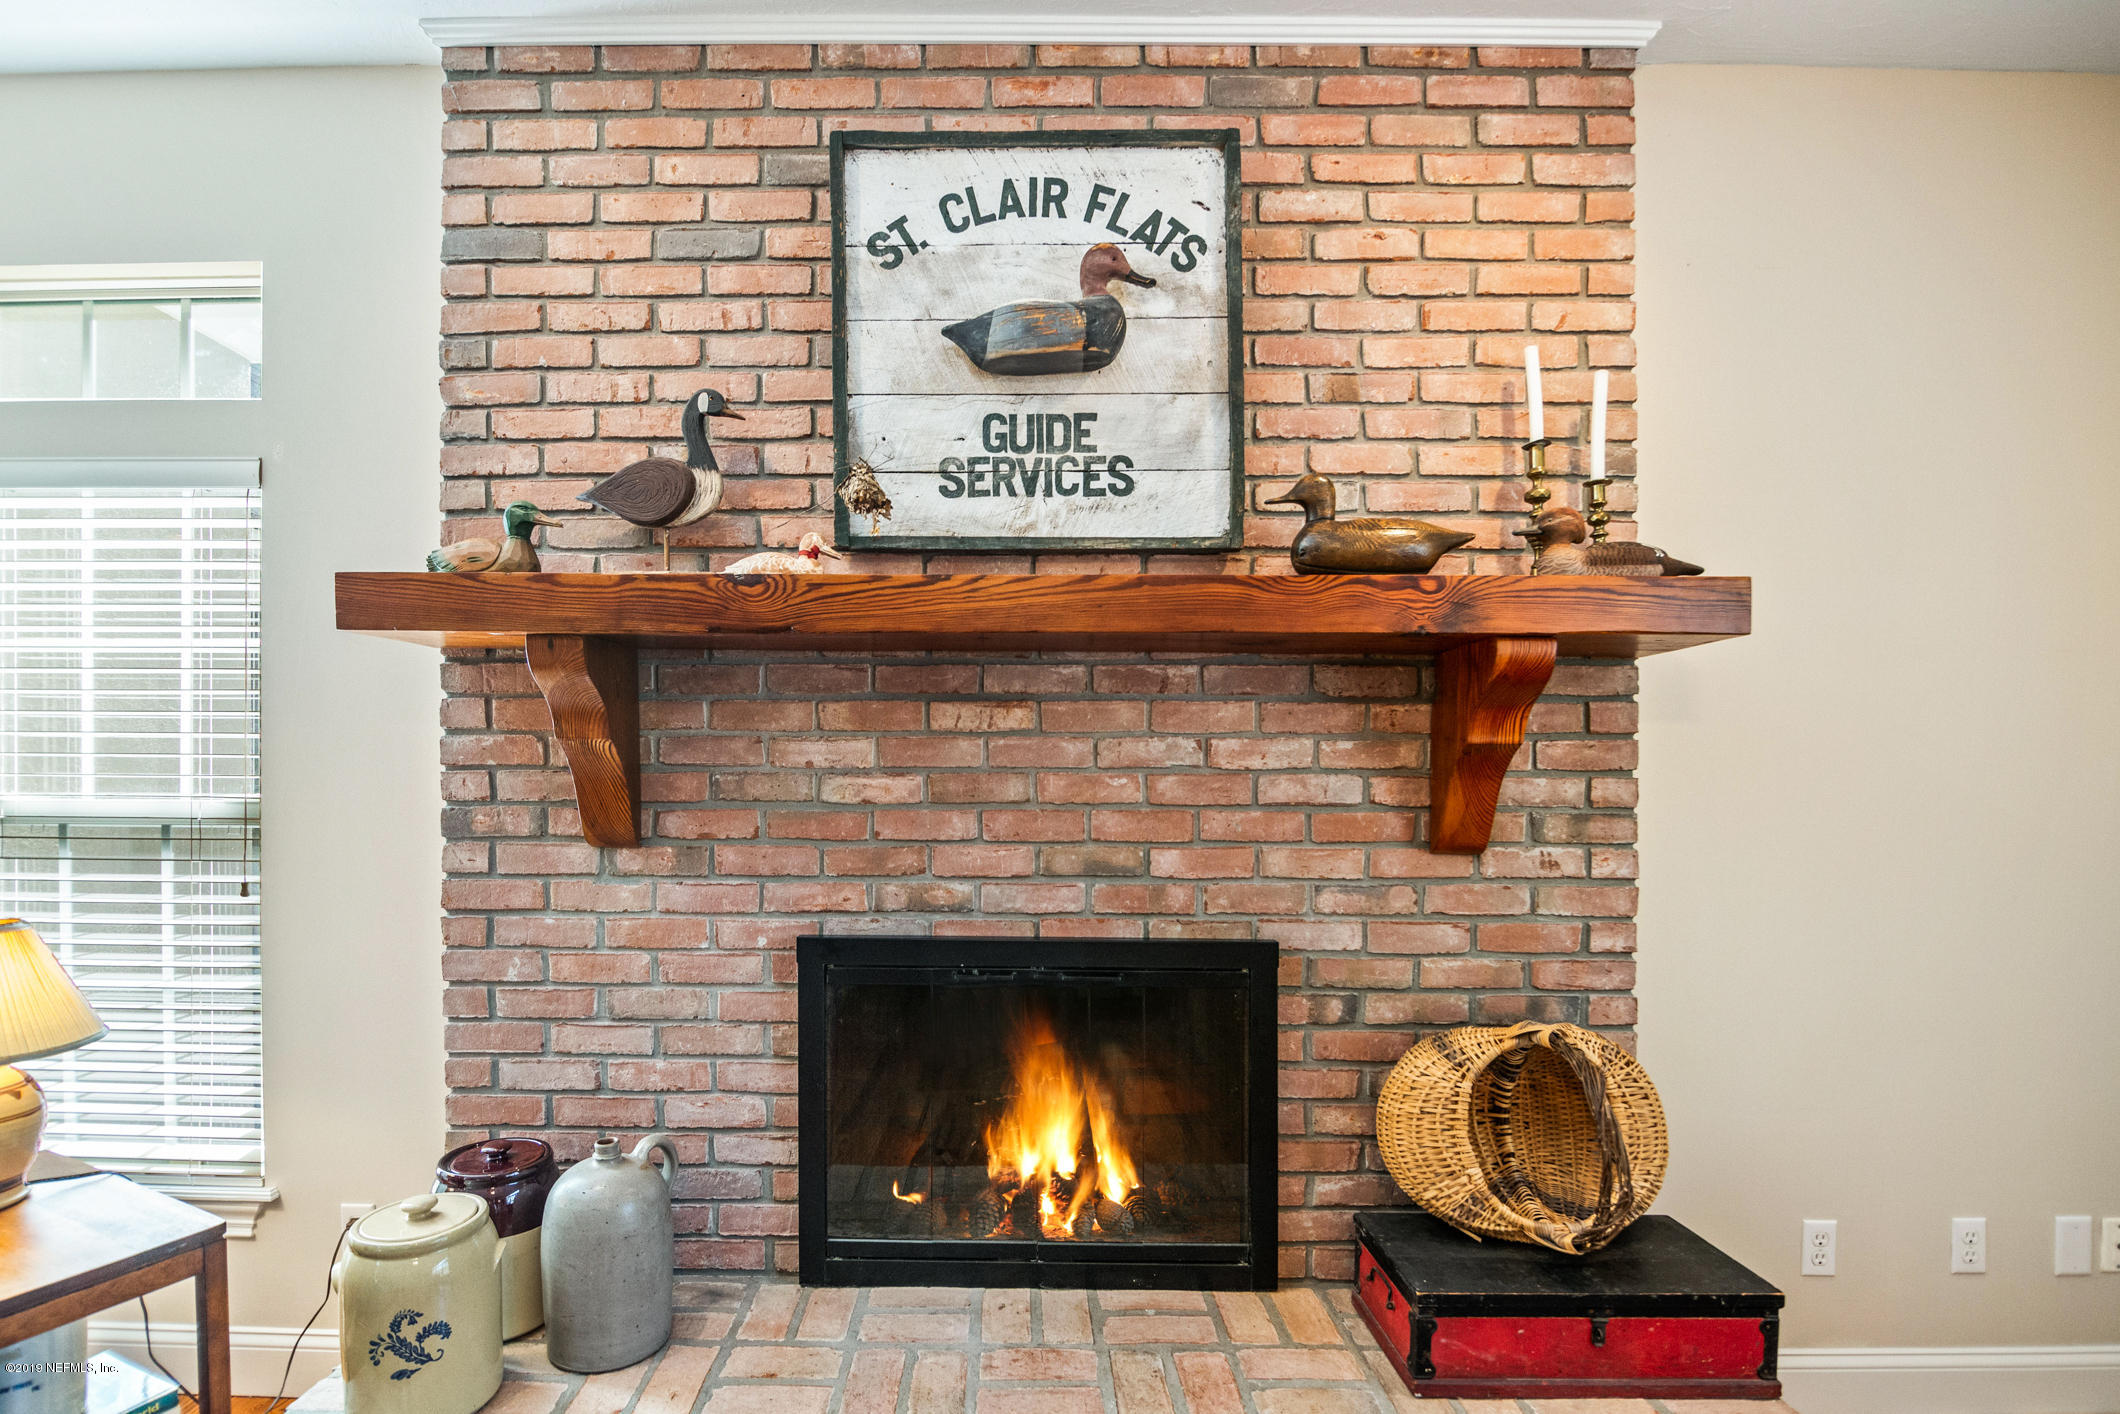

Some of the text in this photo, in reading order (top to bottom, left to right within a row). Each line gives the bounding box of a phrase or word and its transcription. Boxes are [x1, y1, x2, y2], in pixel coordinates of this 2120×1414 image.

[866, 177, 1208, 273] ST. CLAIR FLATS
[982, 413, 1098, 454] GUIDE
[938, 455, 1135, 499] SERVICES
